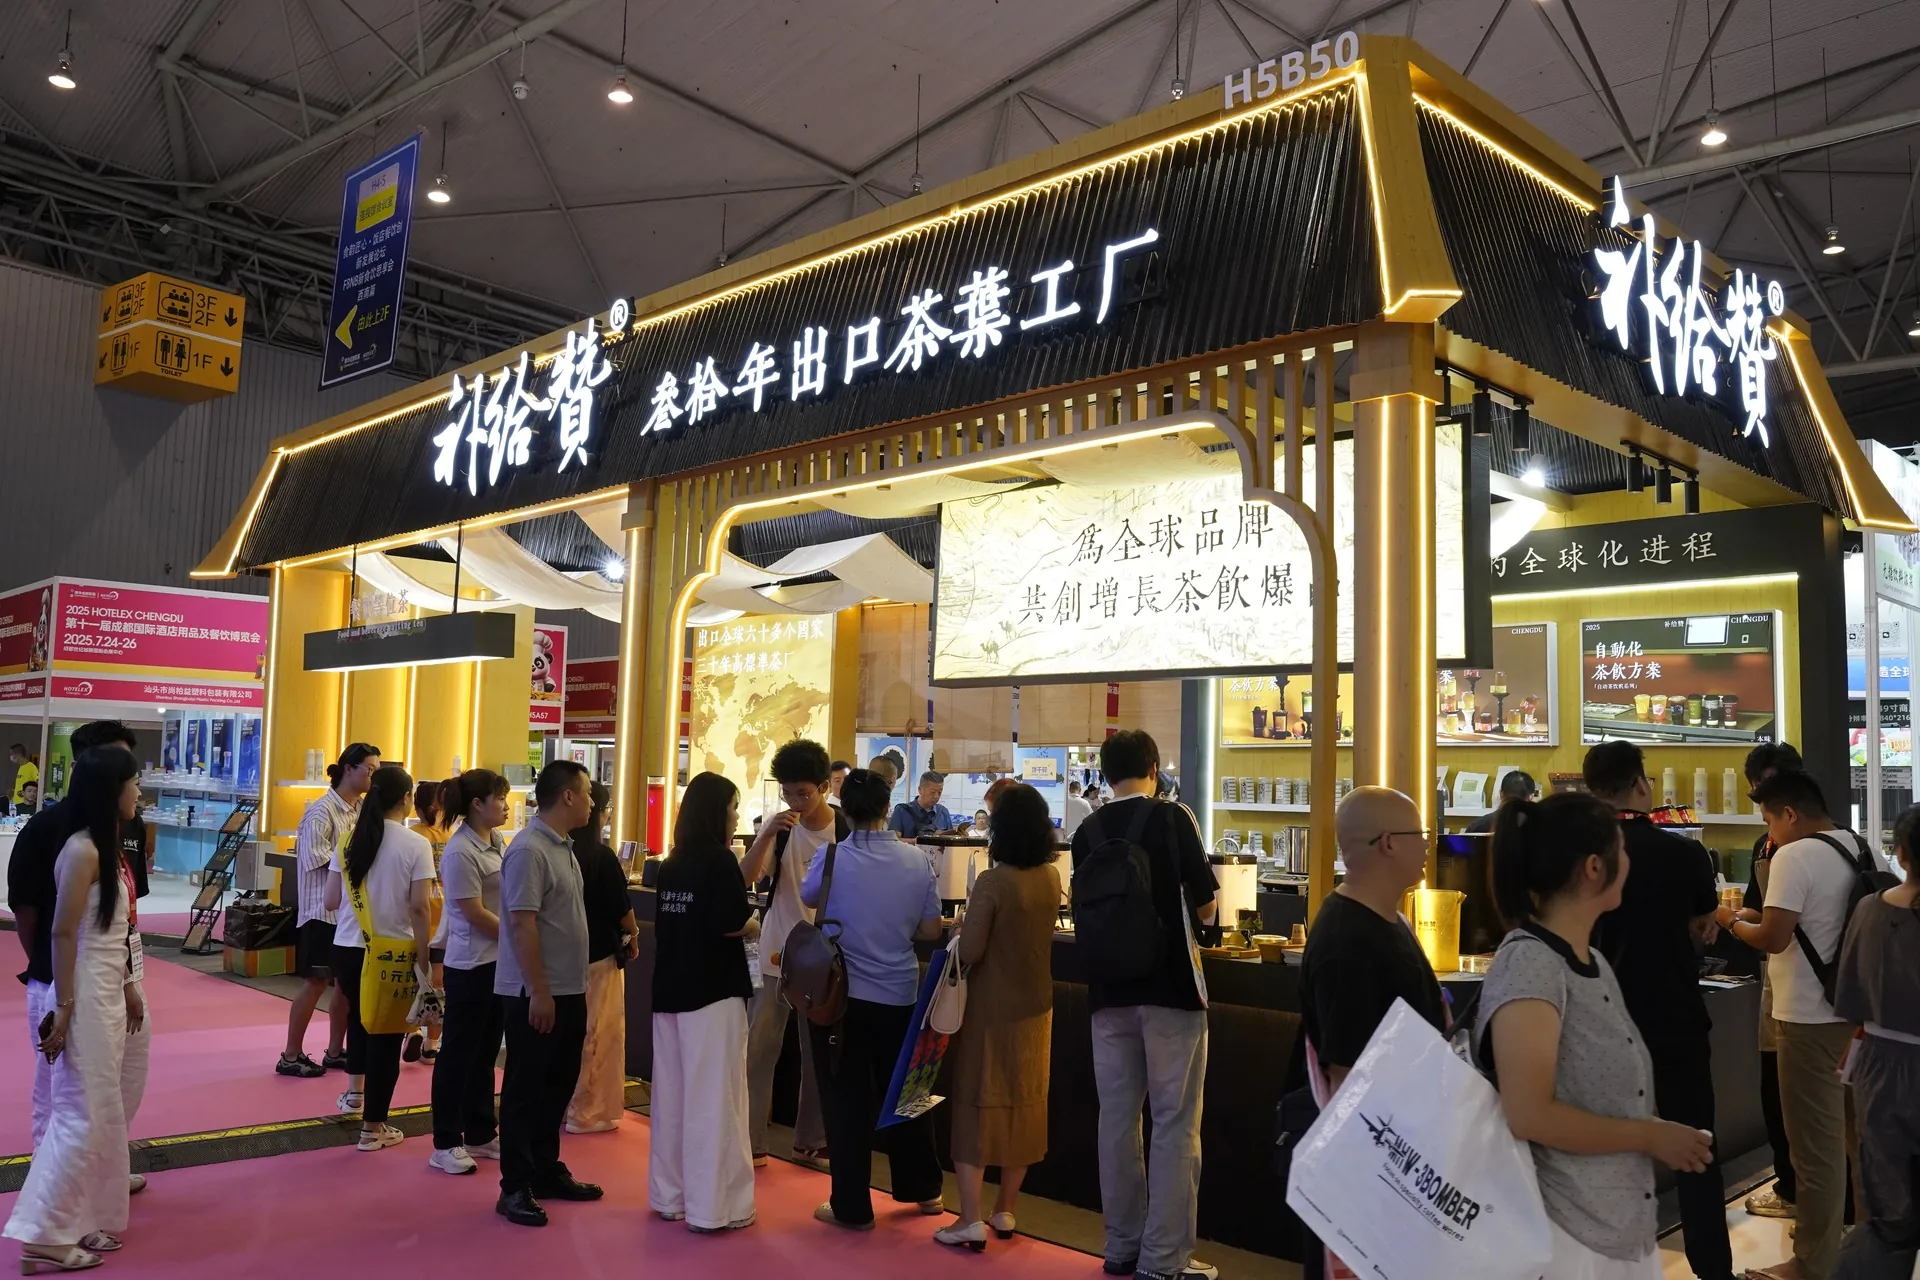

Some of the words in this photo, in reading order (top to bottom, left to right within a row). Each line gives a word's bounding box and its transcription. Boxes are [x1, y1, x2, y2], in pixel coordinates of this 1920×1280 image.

[1225, 30, 1359, 109] H5B50
[134, 281, 147, 299] 3F
[132, 298, 145, 316] 2F
[196, 293, 218, 310] 3F
[194, 310, 217, 327] 2F
[357, 304, 390, 332] 由此上2F
[129, 341, 141, 359] 1F
[193, 352, 213, 369] 1F
[161, 368, 183, 377] TOILET
[1017, 562, 1342, 627] 共創增長茶飲爆
[65, 604, 90, 616] 2025
[91, 606, 133, 620] HOTELEX
[134, 611, 184, 623] CHENGDU
[1730, 614, 1769, 624] CHENGDU
[64, 617, 261, 644] 第十一届成都国际酒店用品及餐饮博览会
[1511, 626, 1544, 635] CHENGDU
[1585, 623, 1601, 631] 2025
[63, 633, 137, 649] 2025.7.24-26
[1594, 640, 1644, 659] 自動化
[1591, 661, 1662, 681] 茶飲方案
[63, 685, 90, 693] HOTELEX
[1423, 1207, 1443, 1227] coffee
[1442, 1224, 1465, 1243] wares
